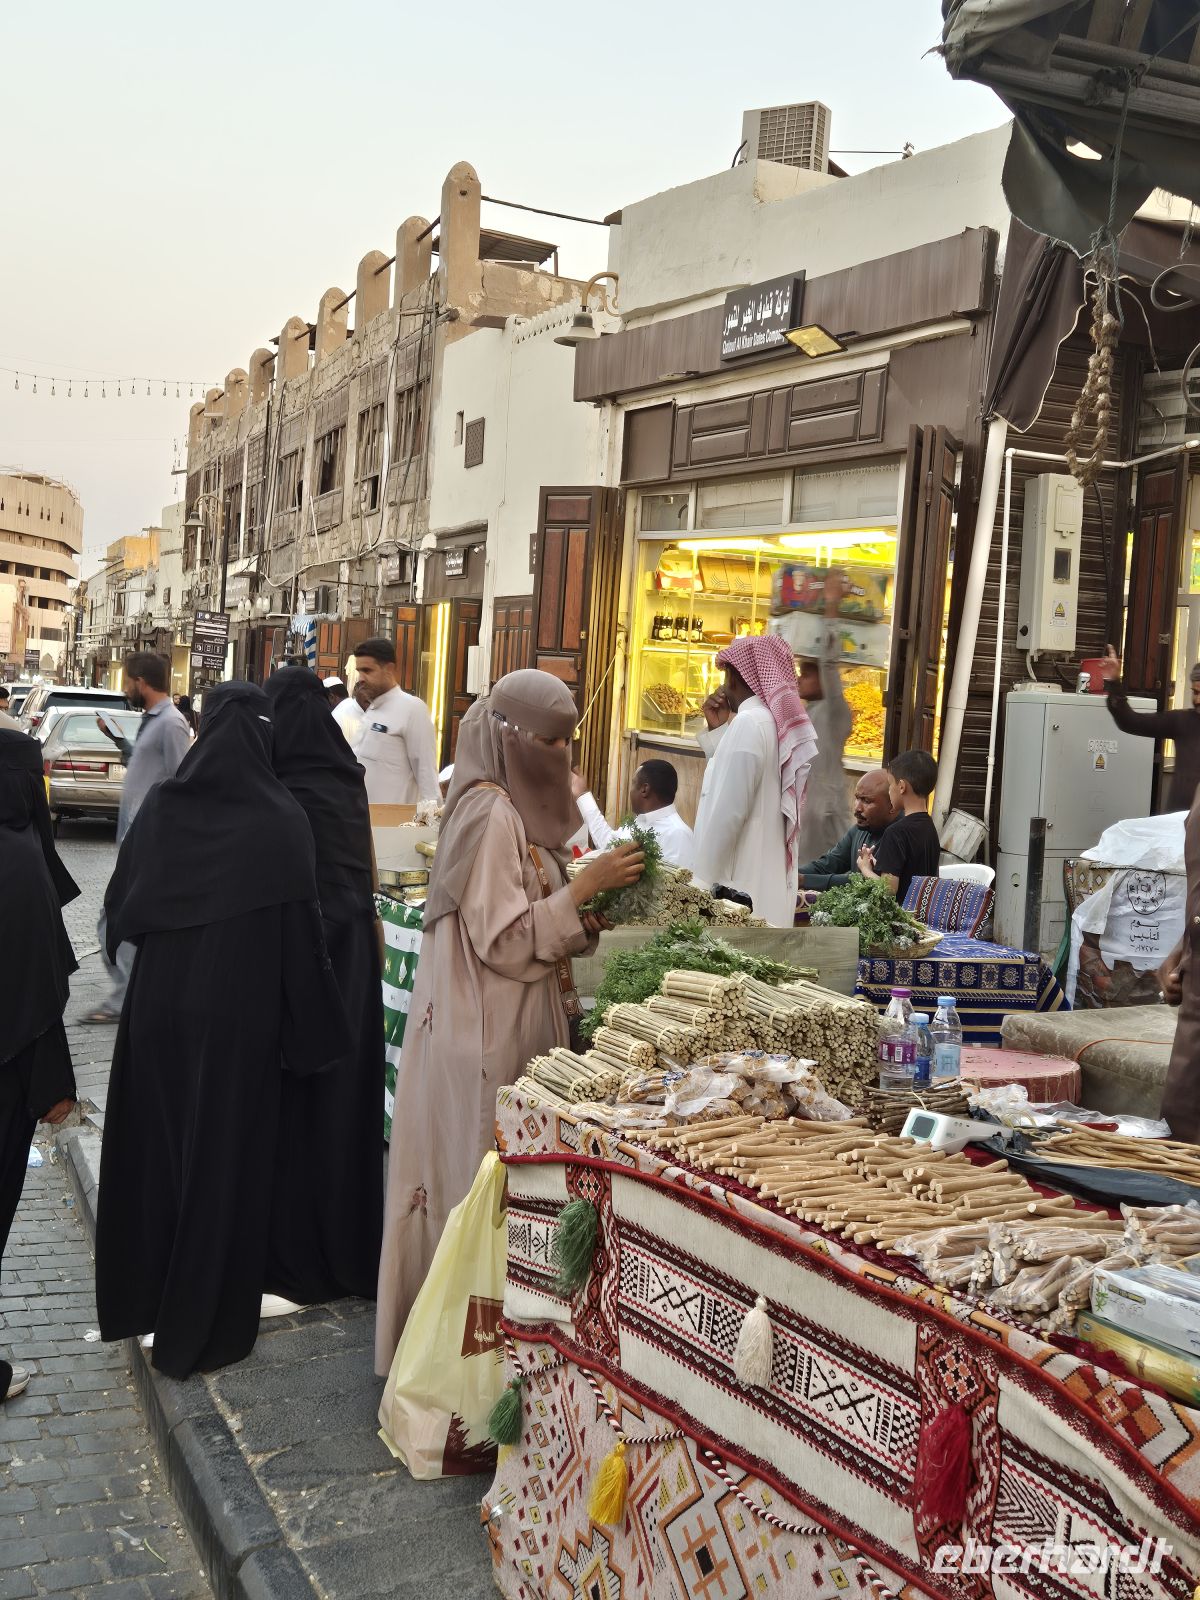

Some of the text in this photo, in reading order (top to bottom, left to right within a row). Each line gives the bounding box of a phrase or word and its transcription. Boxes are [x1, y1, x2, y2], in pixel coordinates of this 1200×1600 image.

[756, 292, 773, 326] قطوف
[775, 285, 790, 320] شركة
[740, 300, 756, 332] الخير
[753, 332, 766, 347] Dates
[1129, 928, 1160, 942] التأسيس
[1130, 919, 1160, 930] يوم
